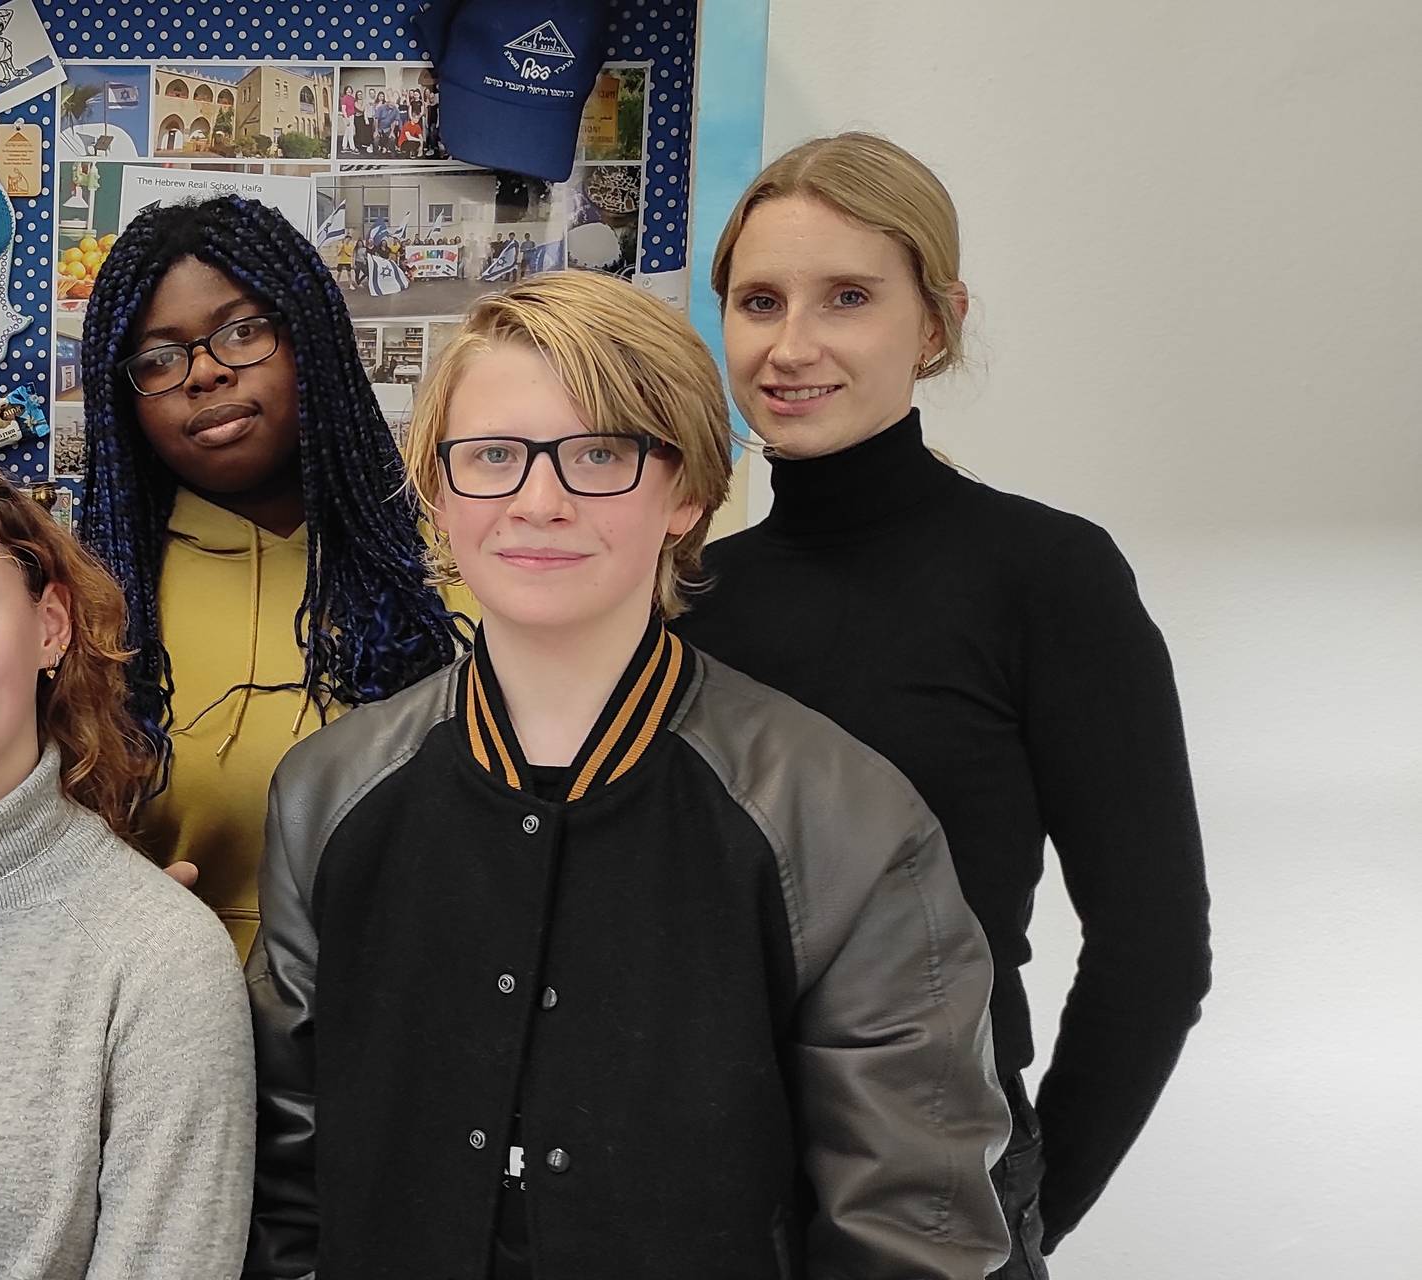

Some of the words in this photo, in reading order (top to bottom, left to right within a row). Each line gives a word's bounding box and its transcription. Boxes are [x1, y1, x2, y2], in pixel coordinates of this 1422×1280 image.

[138, 177, 152, 186] The
[155, 178, 186, 188] Hebrew
[188, 180, 208, 190] Reali
[210, 181, 239, 193] School,
[241, 184, 262, 193] Haifa
